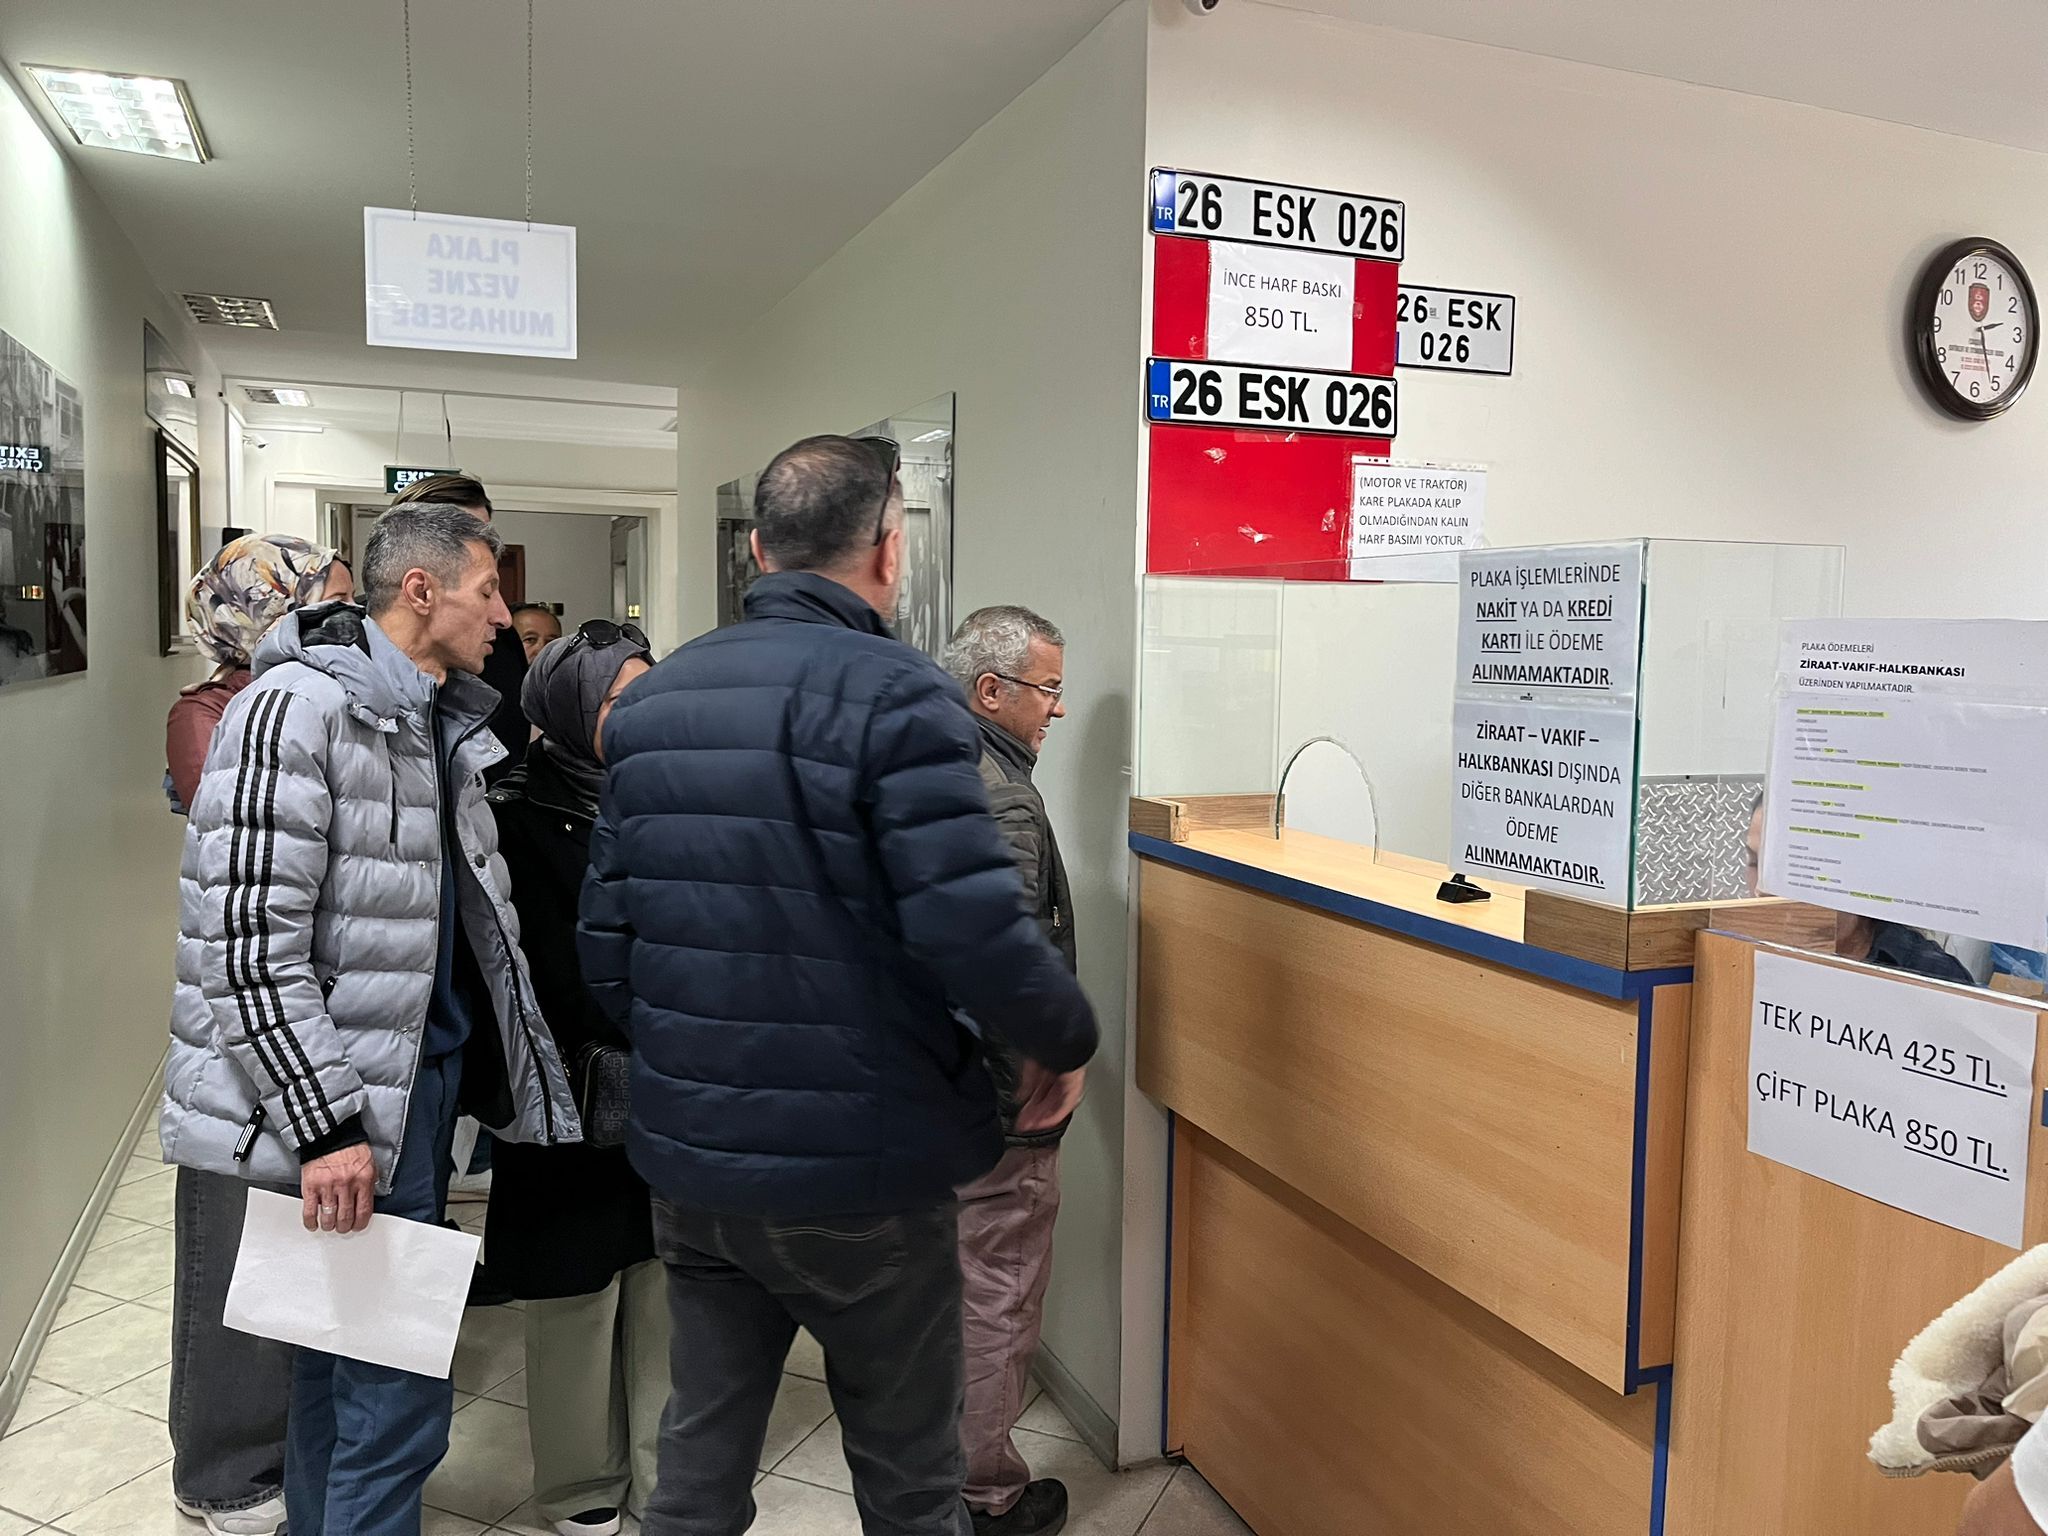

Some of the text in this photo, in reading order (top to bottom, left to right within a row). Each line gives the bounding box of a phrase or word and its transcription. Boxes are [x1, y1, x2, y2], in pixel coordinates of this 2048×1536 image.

[1156, 180, 1398, 252] TR 26 ESK 026
[1955, 268, 1966, 285] 11
[1973, 263, 1987, 280] 12
[1224, 268, 1341, 298] İNCE HARF BASKI
[1997, 274, 2002, 290] 1
[1939, 289, 1953, 306] 10
[2008, 297, 2017, 313] 2
[1245, 306, 1317, 333] 850 TL.
[1397, 293, 1502, 331] 26 ESK
[1934, 316, 1942, 333] 9
[2012, 327, 2022, 343] 3
[1421, 331, 1470, 363] 026
[1938, 347, 1947, 363] 8
[2005, 355, 2015, 372] 4
[1951, 371, 1961, 387] 7
[1991, 376, 2000, 392] 5
[1152, 368, 1392, 428] TR 26 ESK 026
[1970, 381, 1980, 398] 6
[1360, 477, 1402, 489] (MOTOR
[1404, 478, 1417, 489] VE
[1359, 496, 1462, 509] KARE PLAKADA KALIP
[1359, 513, 1469, 527] OLMADIĞINDAN KALIN
[1359, 534, 1385, 545] HARF
[1388, 535, 1422, 545] BASIMI
[1471, 562, 1621, 590] PLAKA İŞLEMLERİNDE
[1476, 595, 1612, 618] NAKİT YA DA KREDİ
[1481, 630, 1604, 651] KARTI İLE ÖDEME
[1801, 641, 1874, 653] PLAKA ÖDEMELERİ
[1472, 664, 1613, 686] ALINMAMAKTADIR.
[1800, 658, 1966, 678] ZİRAAT-VAKIF-HALKBANKASI
[1799, 677, 1844, 689] ÜZERİNDEN
[1477, 720, 1525, 742] ZİRAAT
[1541, 727, 1586, 747] VAKIF
[1458, 752, 1621, 785] HALKBANKASI DIŞINDA
[1462, 780, 1614, 818] DİĞER BANKALARDAN
[1506, 816, 1559, 844] ÖDEME
[1465, 844, 1605, 885] ALINMAMAKTADIR.
[1760, 1001, 2006, 1091] TEK PLAKA 425 TL.
[1756, 1070, 2008, 1174] ÇİFT PLAKA 850 TL.
